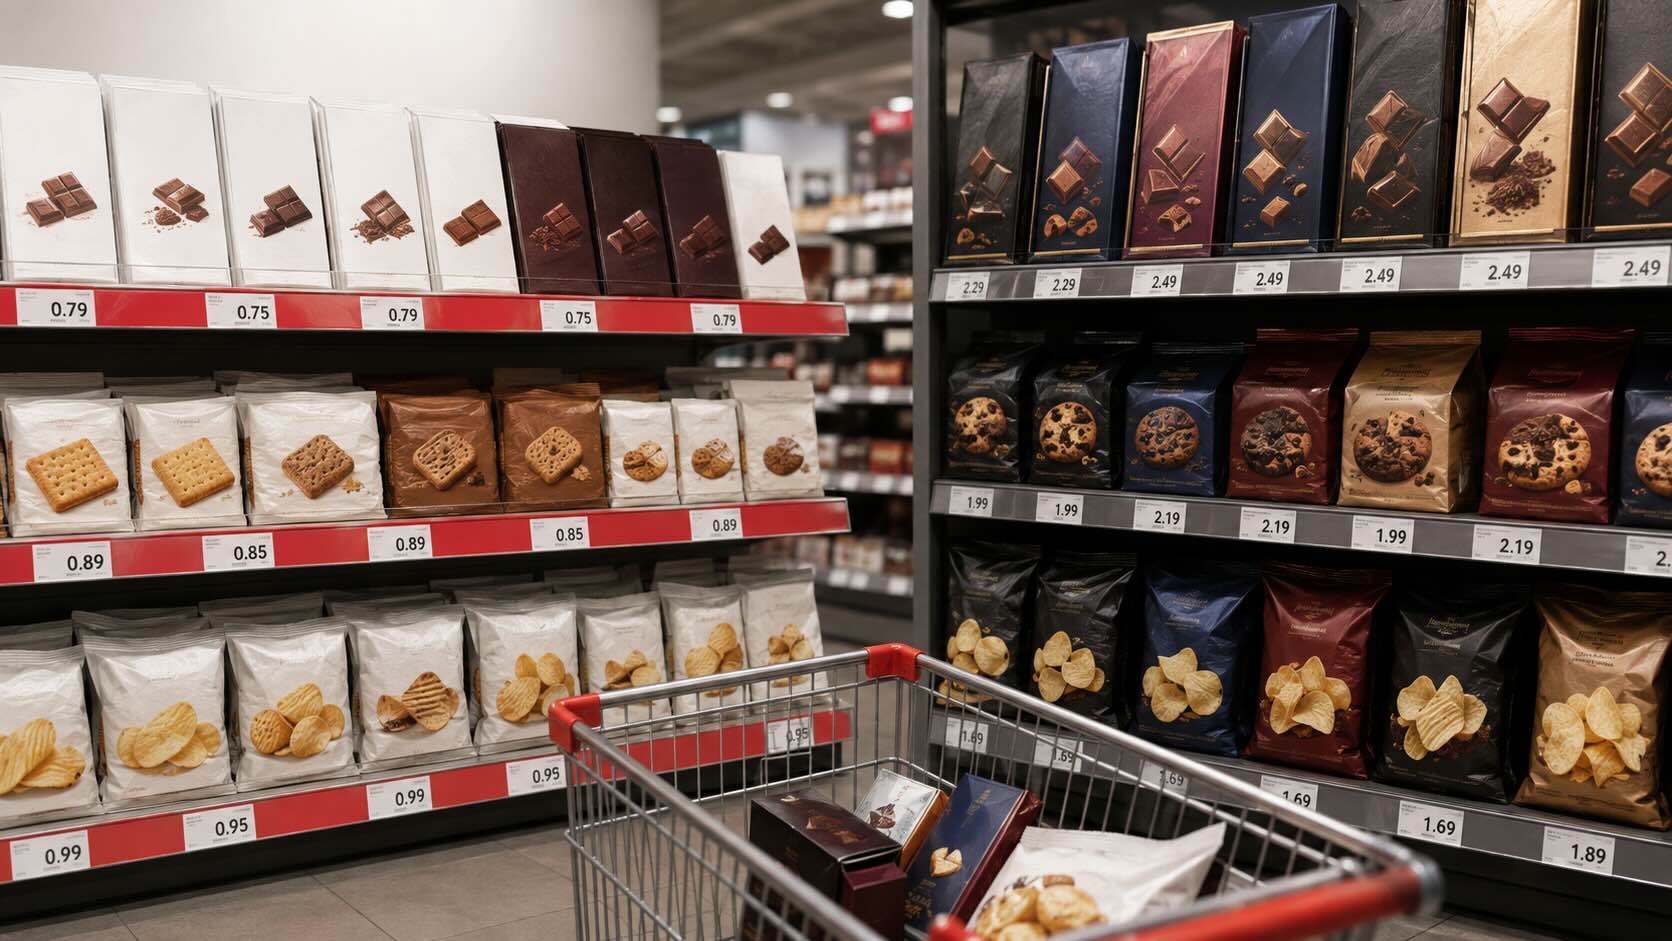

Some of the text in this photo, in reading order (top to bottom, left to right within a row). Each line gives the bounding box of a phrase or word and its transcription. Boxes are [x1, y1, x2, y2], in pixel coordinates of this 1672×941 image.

[1364, 268, 1395, 284] 2.49
[1487, 264, 1522, 281] 2.49
[1623, 259, 1661, 277] 2.49
[1052, 278, 1076, 292] 2.29
[1151, 275, 1177, 289] 2.49
[1255, 271, 1284, 287] 2.49
[963, 281, 985, 295] 2.29
[51, 301, 88, 317] 0.79
[237, 305, 270, 320] 0.75
[388, 308, 418, 322] 0.79
[565, 311, 592, 325] 0.75
[712, 313, 737, 327] 0.79
[967, 496, 989, 510] 1.99
[1055, 503, 1078, 517] 1.99
[712, 518, 737, 532] 0.89
[1154, 510, 1181, 525] 2.19
[555, 527, 584, 542] 0.85
[1261, 519, 1290, 535] 2.19
[395, 536, 426, 552] 0.89
[1376, 528, 1407, 545] 1.99
[233, 544, 267, 561] 0.85
[1499, 538, 1534, 555] 2.19
[67, 553, 104, 572] 0.89
[532, 766, 560, 784] 0.95
[395, 788, 425, 807] 0.99
[1282, 790, 1311, 808] 169
[215, 817, 249, 837] 0.95
[1424, 816, 1456, 836] 1.69
[44, 844, 82, 865] 0.99
[1571, 843, 1606, 864] 1.89
